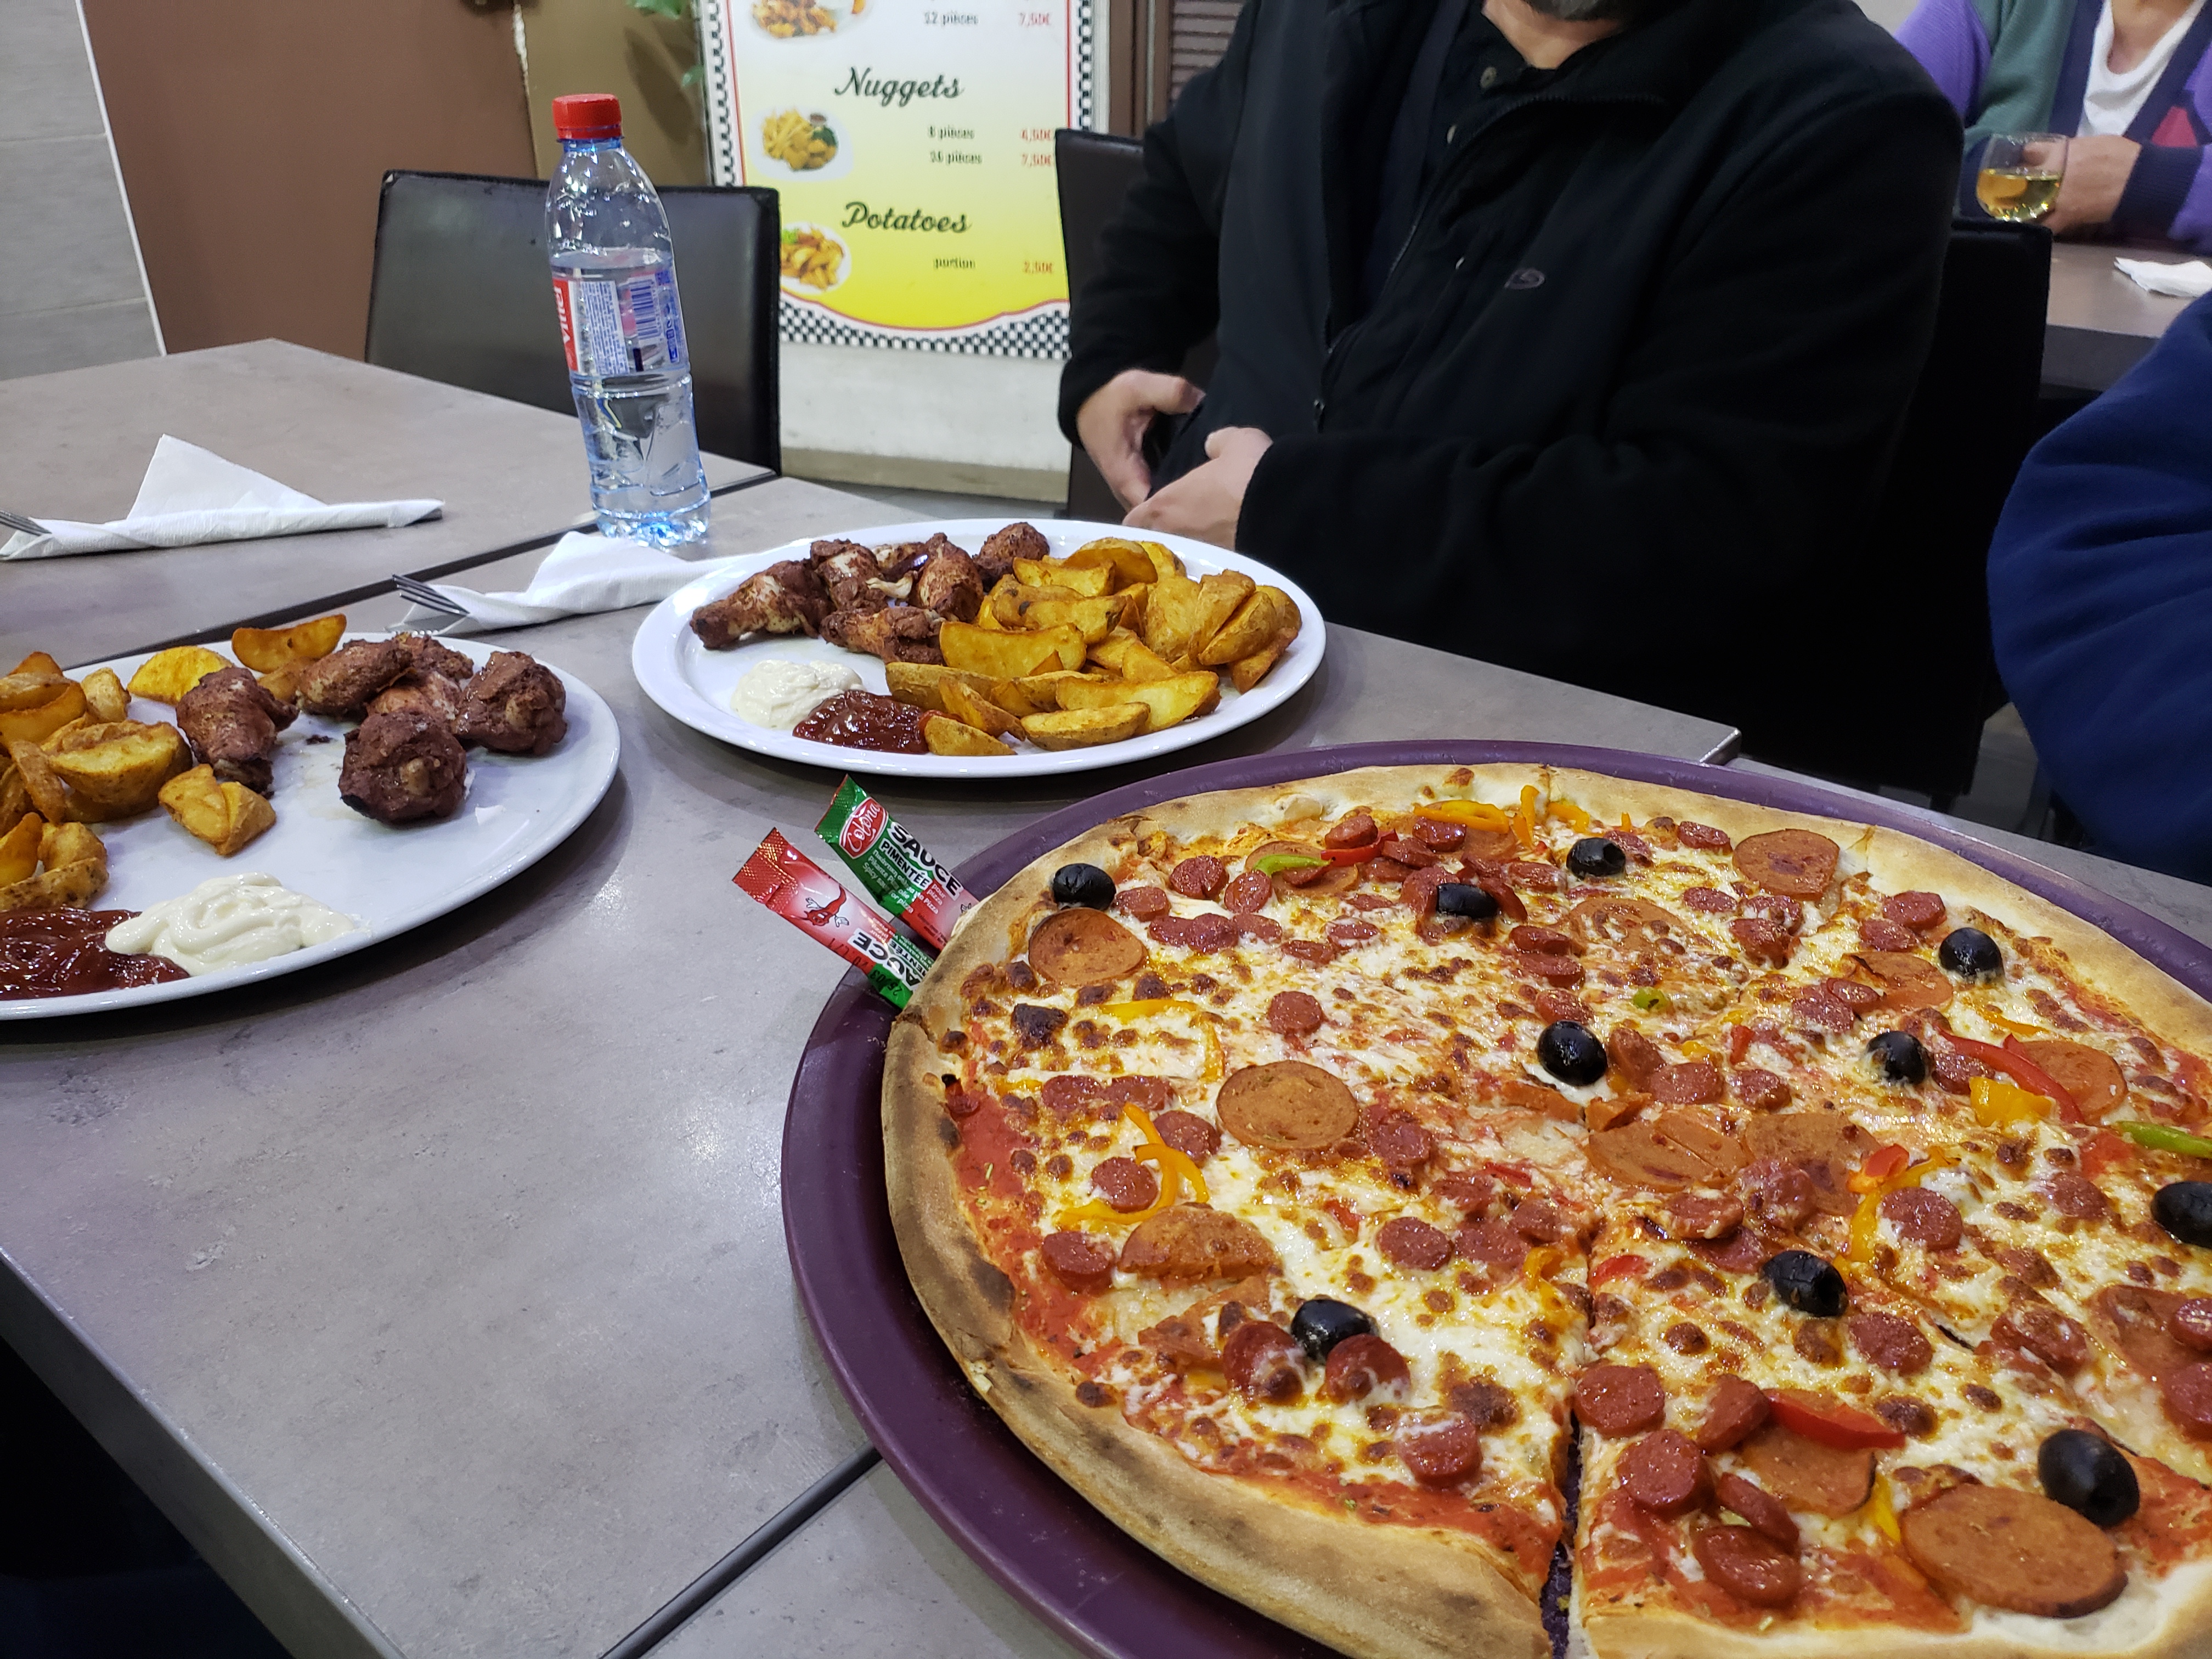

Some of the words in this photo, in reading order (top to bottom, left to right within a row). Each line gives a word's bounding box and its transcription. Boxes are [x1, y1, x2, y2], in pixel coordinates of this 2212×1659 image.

[834, 66, 964, 107] Nuggets
[842, 201, 972, 233] Potatoes
[848, 804, 881, 852] Colona
[868, 855, 888, 878] Pikante
[880, 840, 930, 888] PIMENTÉE
[891, 825, 962, 896] SAUCE
[862, 862, 878, 879] Spicy
[896, 898, 914, 913] pizza
[923, 897, 939, 915] Pizza
[927, 888, 943, 906] pizza
[931, 883, 946, 899] pour
[853, 932, 921, 986] AUCE
[889, 940, 926, 977] ENTÉE
